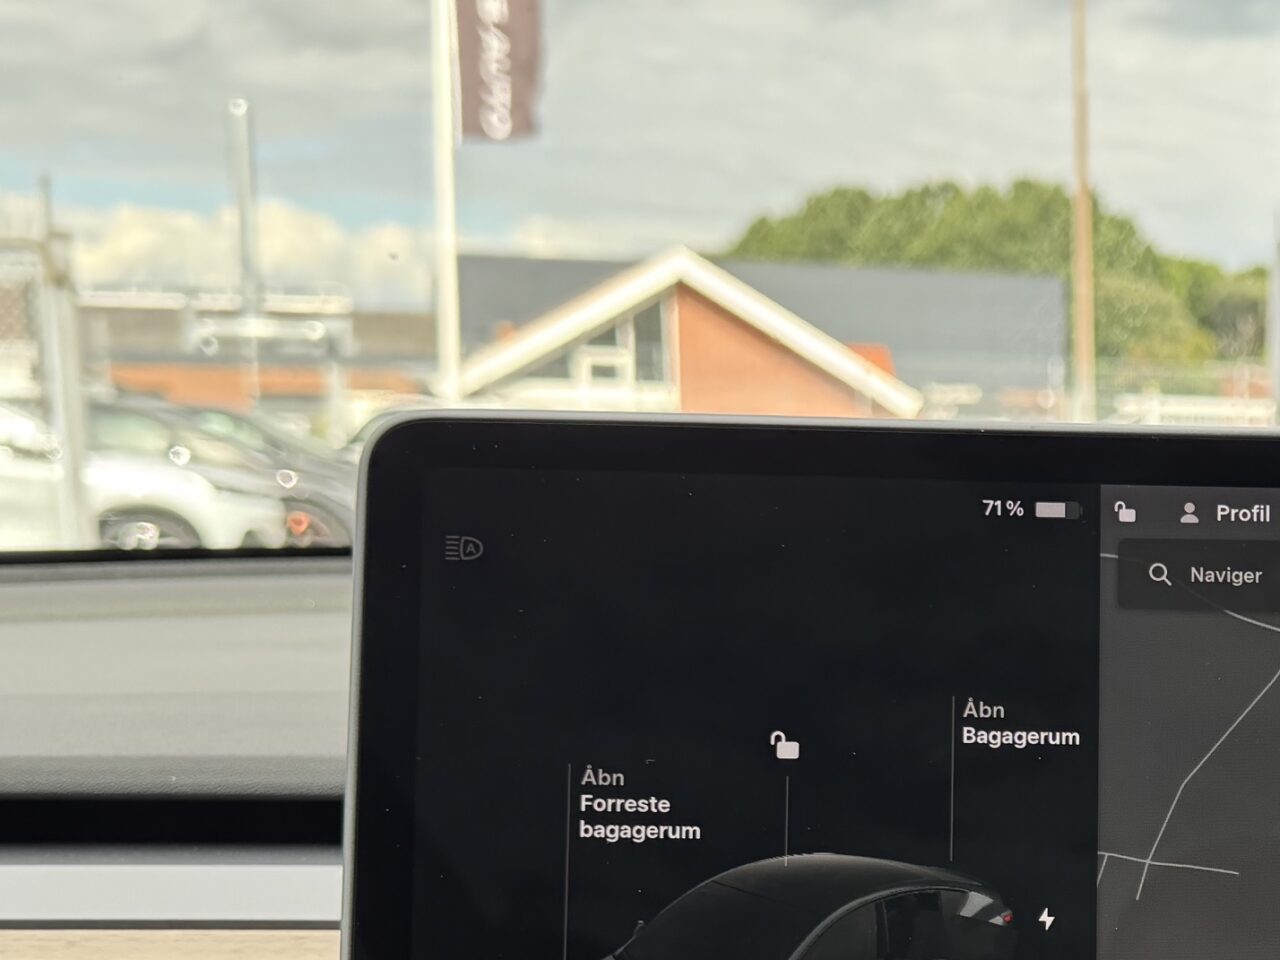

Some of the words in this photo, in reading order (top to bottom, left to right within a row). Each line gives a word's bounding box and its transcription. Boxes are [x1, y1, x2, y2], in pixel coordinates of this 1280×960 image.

[983, 500, 1024, 519] 71%
[1216, 503, 1271, 524] Profil
[1190, 566, 1263, 587] Naviger
[963, 698, 1006, 719] Åbn
[962, 727, 1081, 747] Bagagerum
[581, 764, 625, 787] Åbn
[580, 795, 671, 814] Forreste
[579, 821, 701, 843] bagagerum
